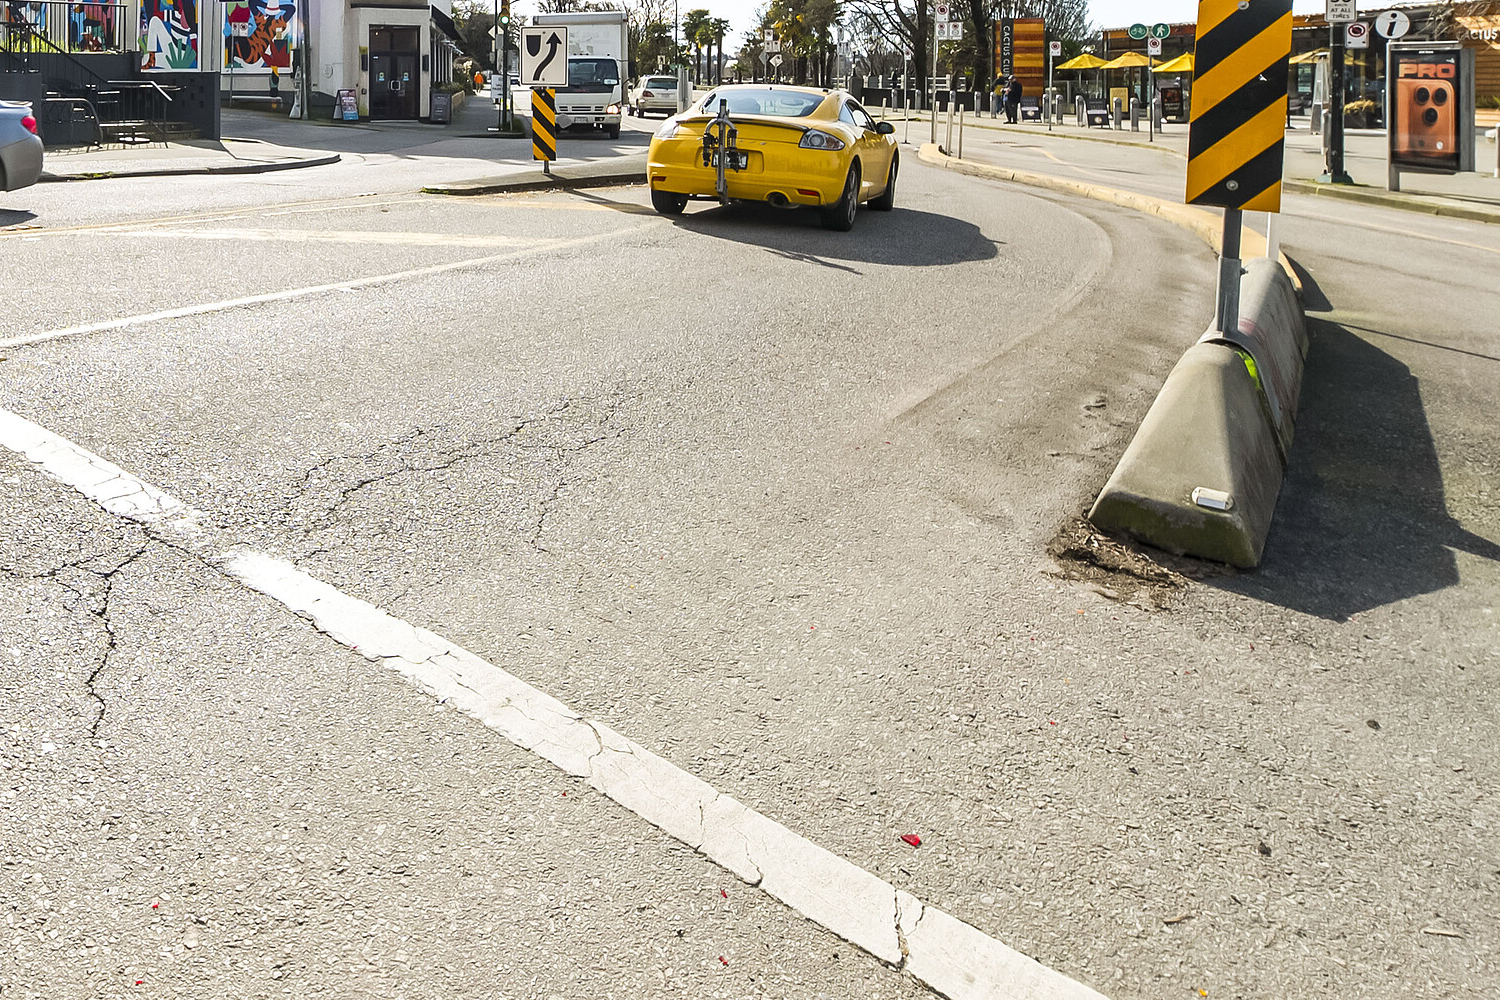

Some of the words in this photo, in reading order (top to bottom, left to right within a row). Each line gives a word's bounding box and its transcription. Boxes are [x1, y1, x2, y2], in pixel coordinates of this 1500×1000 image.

[1003, 25, 1011, 56] CACTUS
[1456, 29, 1498, 41] CACTUS
[1398, 63, 1456, 79] PRO
